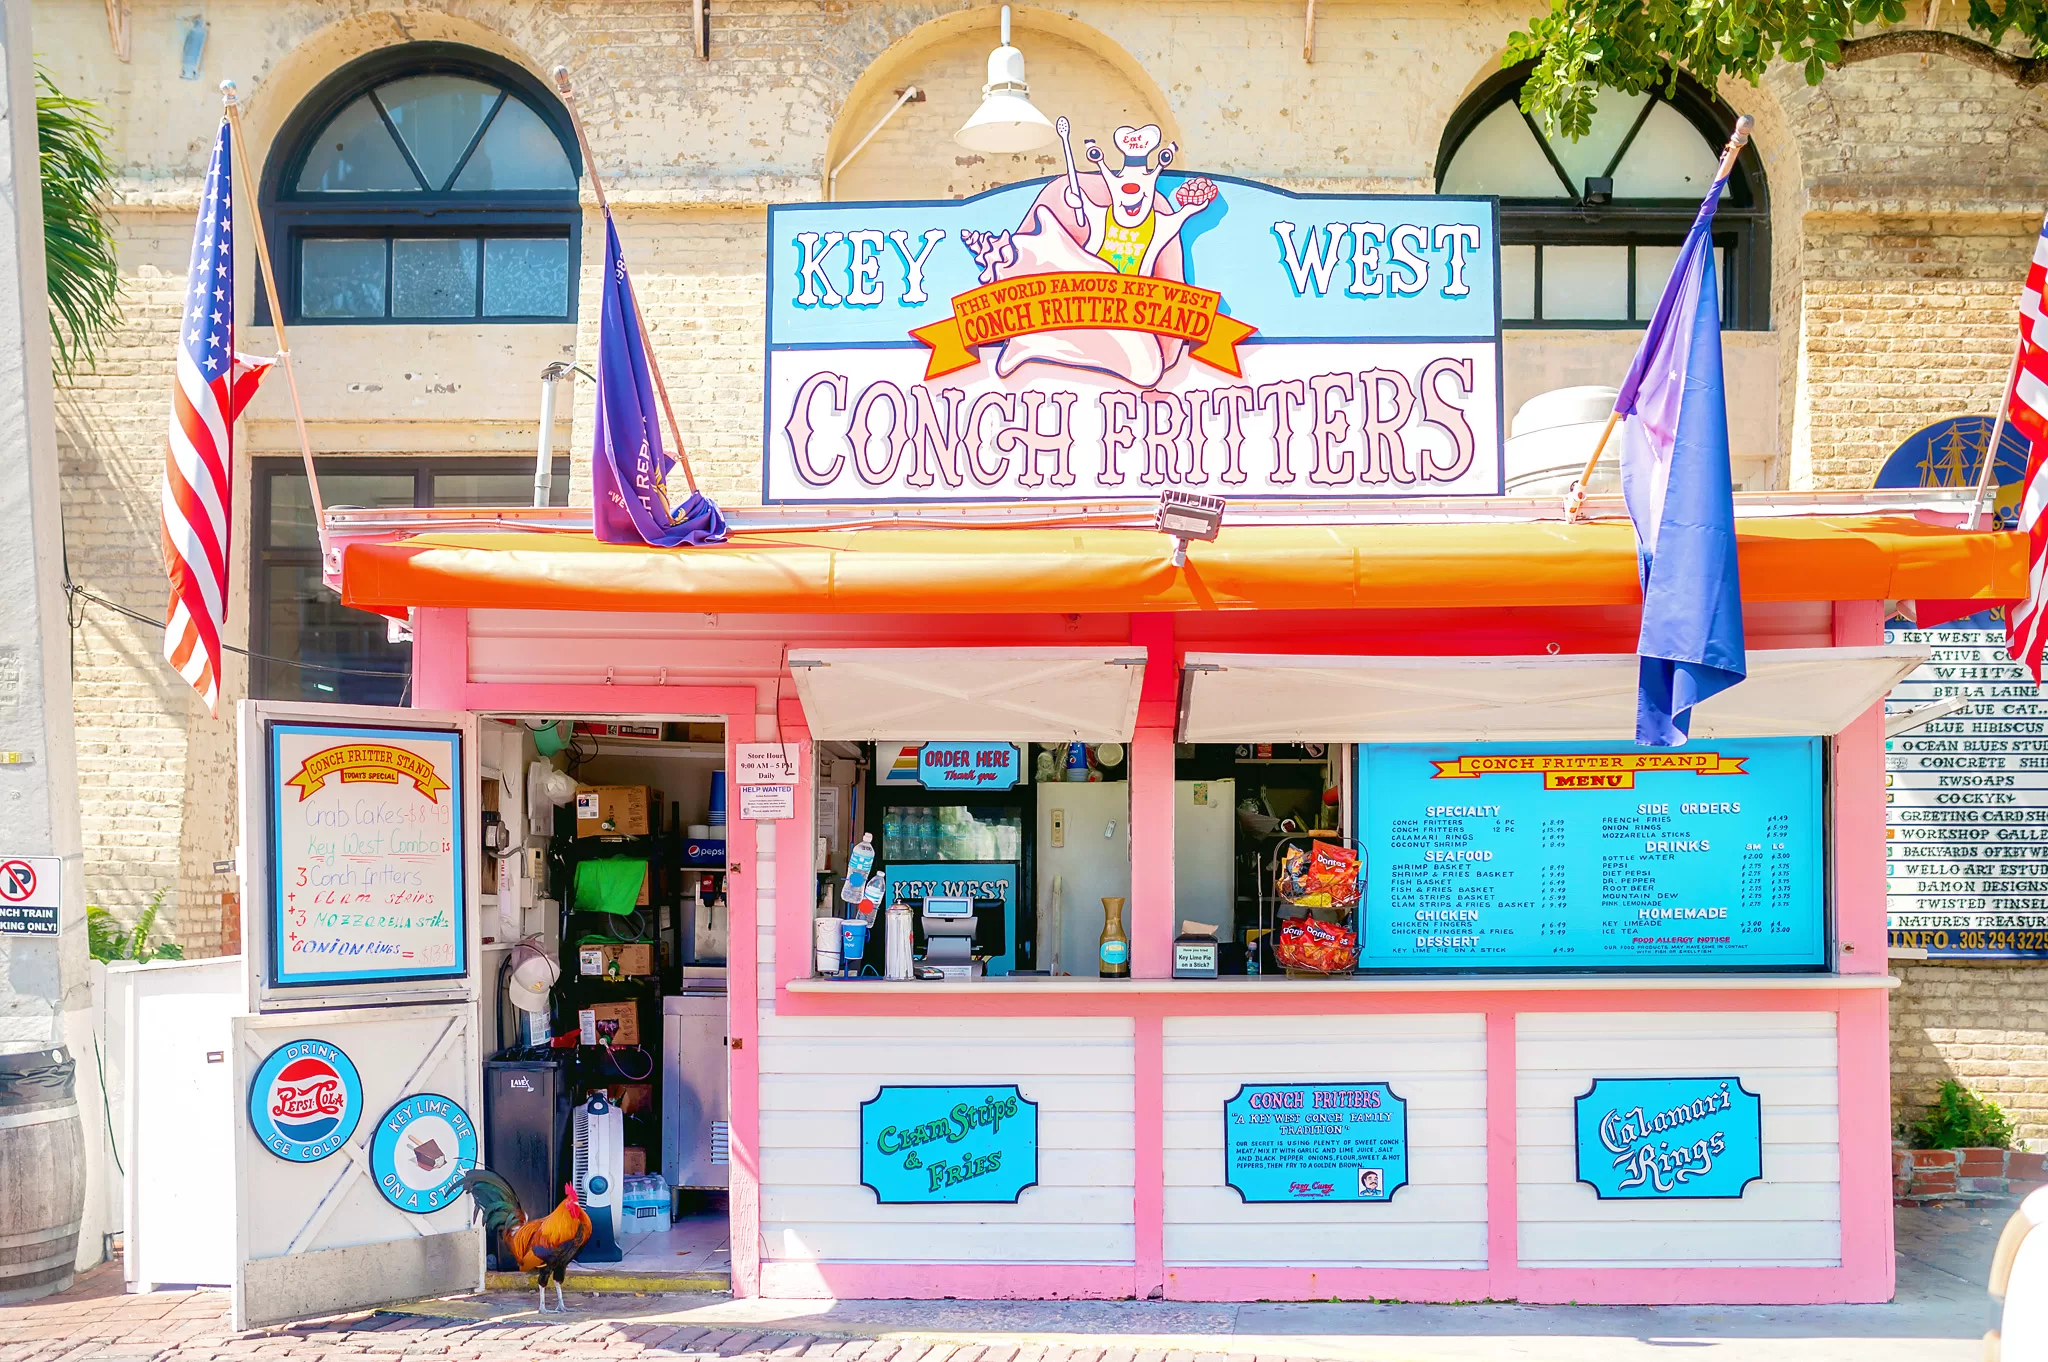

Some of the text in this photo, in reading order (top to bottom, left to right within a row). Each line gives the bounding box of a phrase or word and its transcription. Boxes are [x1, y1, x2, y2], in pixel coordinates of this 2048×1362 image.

[1123, 134, 1142, 144] Eat
[1129, 140, 1149, 149] Me!
[1108, 227, 1139, 240] KEY
[1104, 239, 1145, 256] WEST
[795, 219, 1481, 307] KEY WEST
[957, 278, 1212, 317] THE WORLD FAMOUS KEY WEST
[965, 296, 1210, 343] CONCH FRITTER STAND
[784, 357, 1476, 490] CONCH FRITTERS
[1903, 632, 1980, 642] KEY WEST
[1934, 668, 2023, 678] WHIT'S
[1992, 686, 2039, 696] LAINE
[1925, 723, 2044, 733] BLUE HIBISCUS
[310, 750, 430, 779] CONCH FRITTER STAND
[925, 751, 1010, 767] ORDER HERE
[1471, 756, 1707, 769] CONCH FRITTER STAND
[1921, 758, 2006, 768] CONCRETE
[344, 772, 367, 780] TODAY'S
[944, 770, 998, 785] Thank you
[1554, 775, 1623, 787] MENU
[1939, 776, 2014, 786] KWSOAPS
[306, 799, 349, 827] Crab
[1426, 806, 1500, 817] SPECIALTY
[1637, 802, 1741, 815] SIDE ORDERS
[1900, 811, 2023, 821] GREETING CARD
[1902, 829, 1989, 839] WORKSHOP
[308, 828, 451, 866] Key West Combo is
[701, 848, 724, 856] pepsi
[1645, 840, 1710, 853] DRINKS
[1318, 854, 1346, 868] Doritos
[1424, 850, 1493, 862] SEAFOOD
[1906, 865, 1995, 875] WELLO ART
[296, 864, 422, 892] 3 Conch fritters
[892, 879, 1009, 902] KEY WEST
[1919, 881, 2048, 891] DAMON DESIGNS
[1917, 899, 2048, 909] TWISTED TINSEL
[22, 909, 53, 918] TRAIN
[1415, 910, 1479, 921] CHICKEN
[1638, 908, 1727, 920] HOMEMADE
[27, 923, 56, 931] ONLY!
[1306, 926, 1335, 941] Doritos
[1416, 936, 1480, 948] DESSERT
[1890, 931, 1957, 948] INFO.
[1960, 932, 1985, 949] 305
[1989, 932, 2015, 949] 294
[286, 1043, 339, 1064] DRINK
[1250, 1090, 1381, 1110] CONCH FRITTERS
[388, 1099, 472, 1140] KEY LIME PIE
[947, 1095, 1017, 1143] Strips
[1250, 1113, 1272, 1124] KEY
[1274, 1113, 1301, 1124] WEST
[1305, 1113, 1343, 1123] CONCH
[1350, 1112, 1392, 1123] FAMILY
[1599, 1081, 1731, 1154] Calamari
[267, 1133, 342, 1158] ICE COLD
[903, 1150, 923, 1170] &
[1613, 1131, 1725, 1193] Rings
[383, 1173, 405, 1199] ON
[407, 1192, 418, 1208] A
